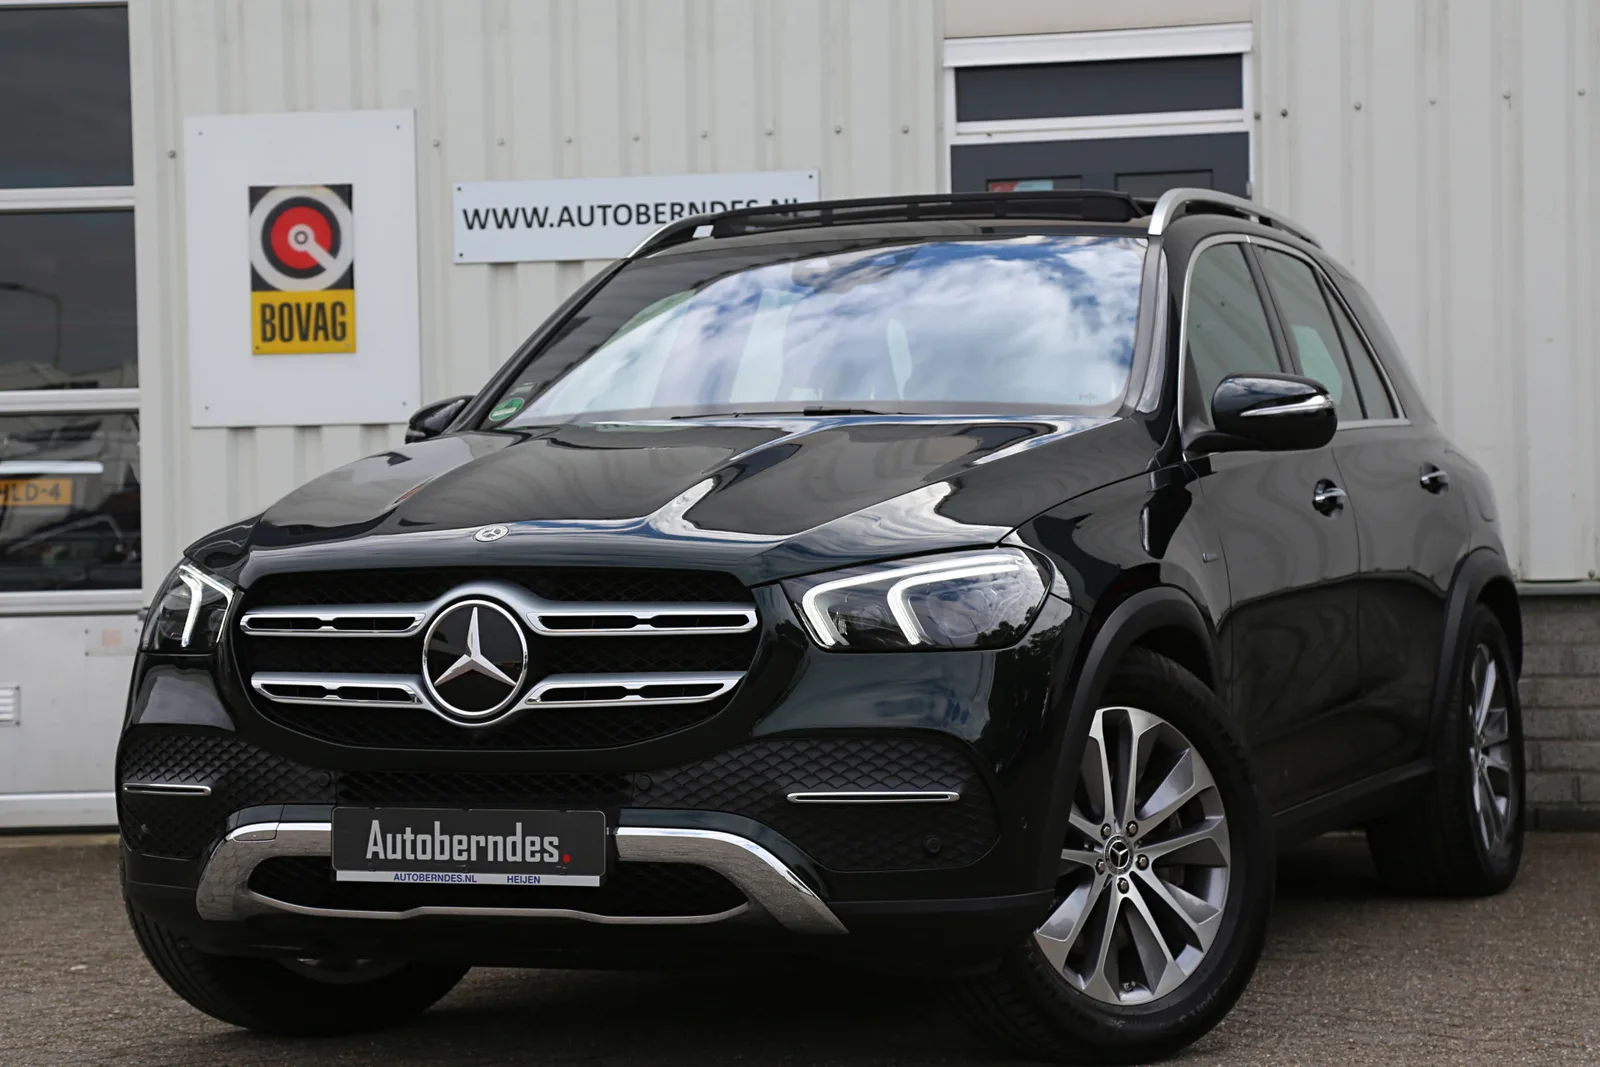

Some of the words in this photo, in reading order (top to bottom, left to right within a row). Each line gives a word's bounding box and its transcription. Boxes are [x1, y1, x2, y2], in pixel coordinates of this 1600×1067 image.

[463, 197, 798, 230] WWW.AUTOBERND
[260, 301, 347, 342] BOVAG
[365, 819, 571, 863] Autoberndes.
[393, 873, 478, 883] AUTOBERNDES.NL
[506, 875, 541, 884] HEIJEN
